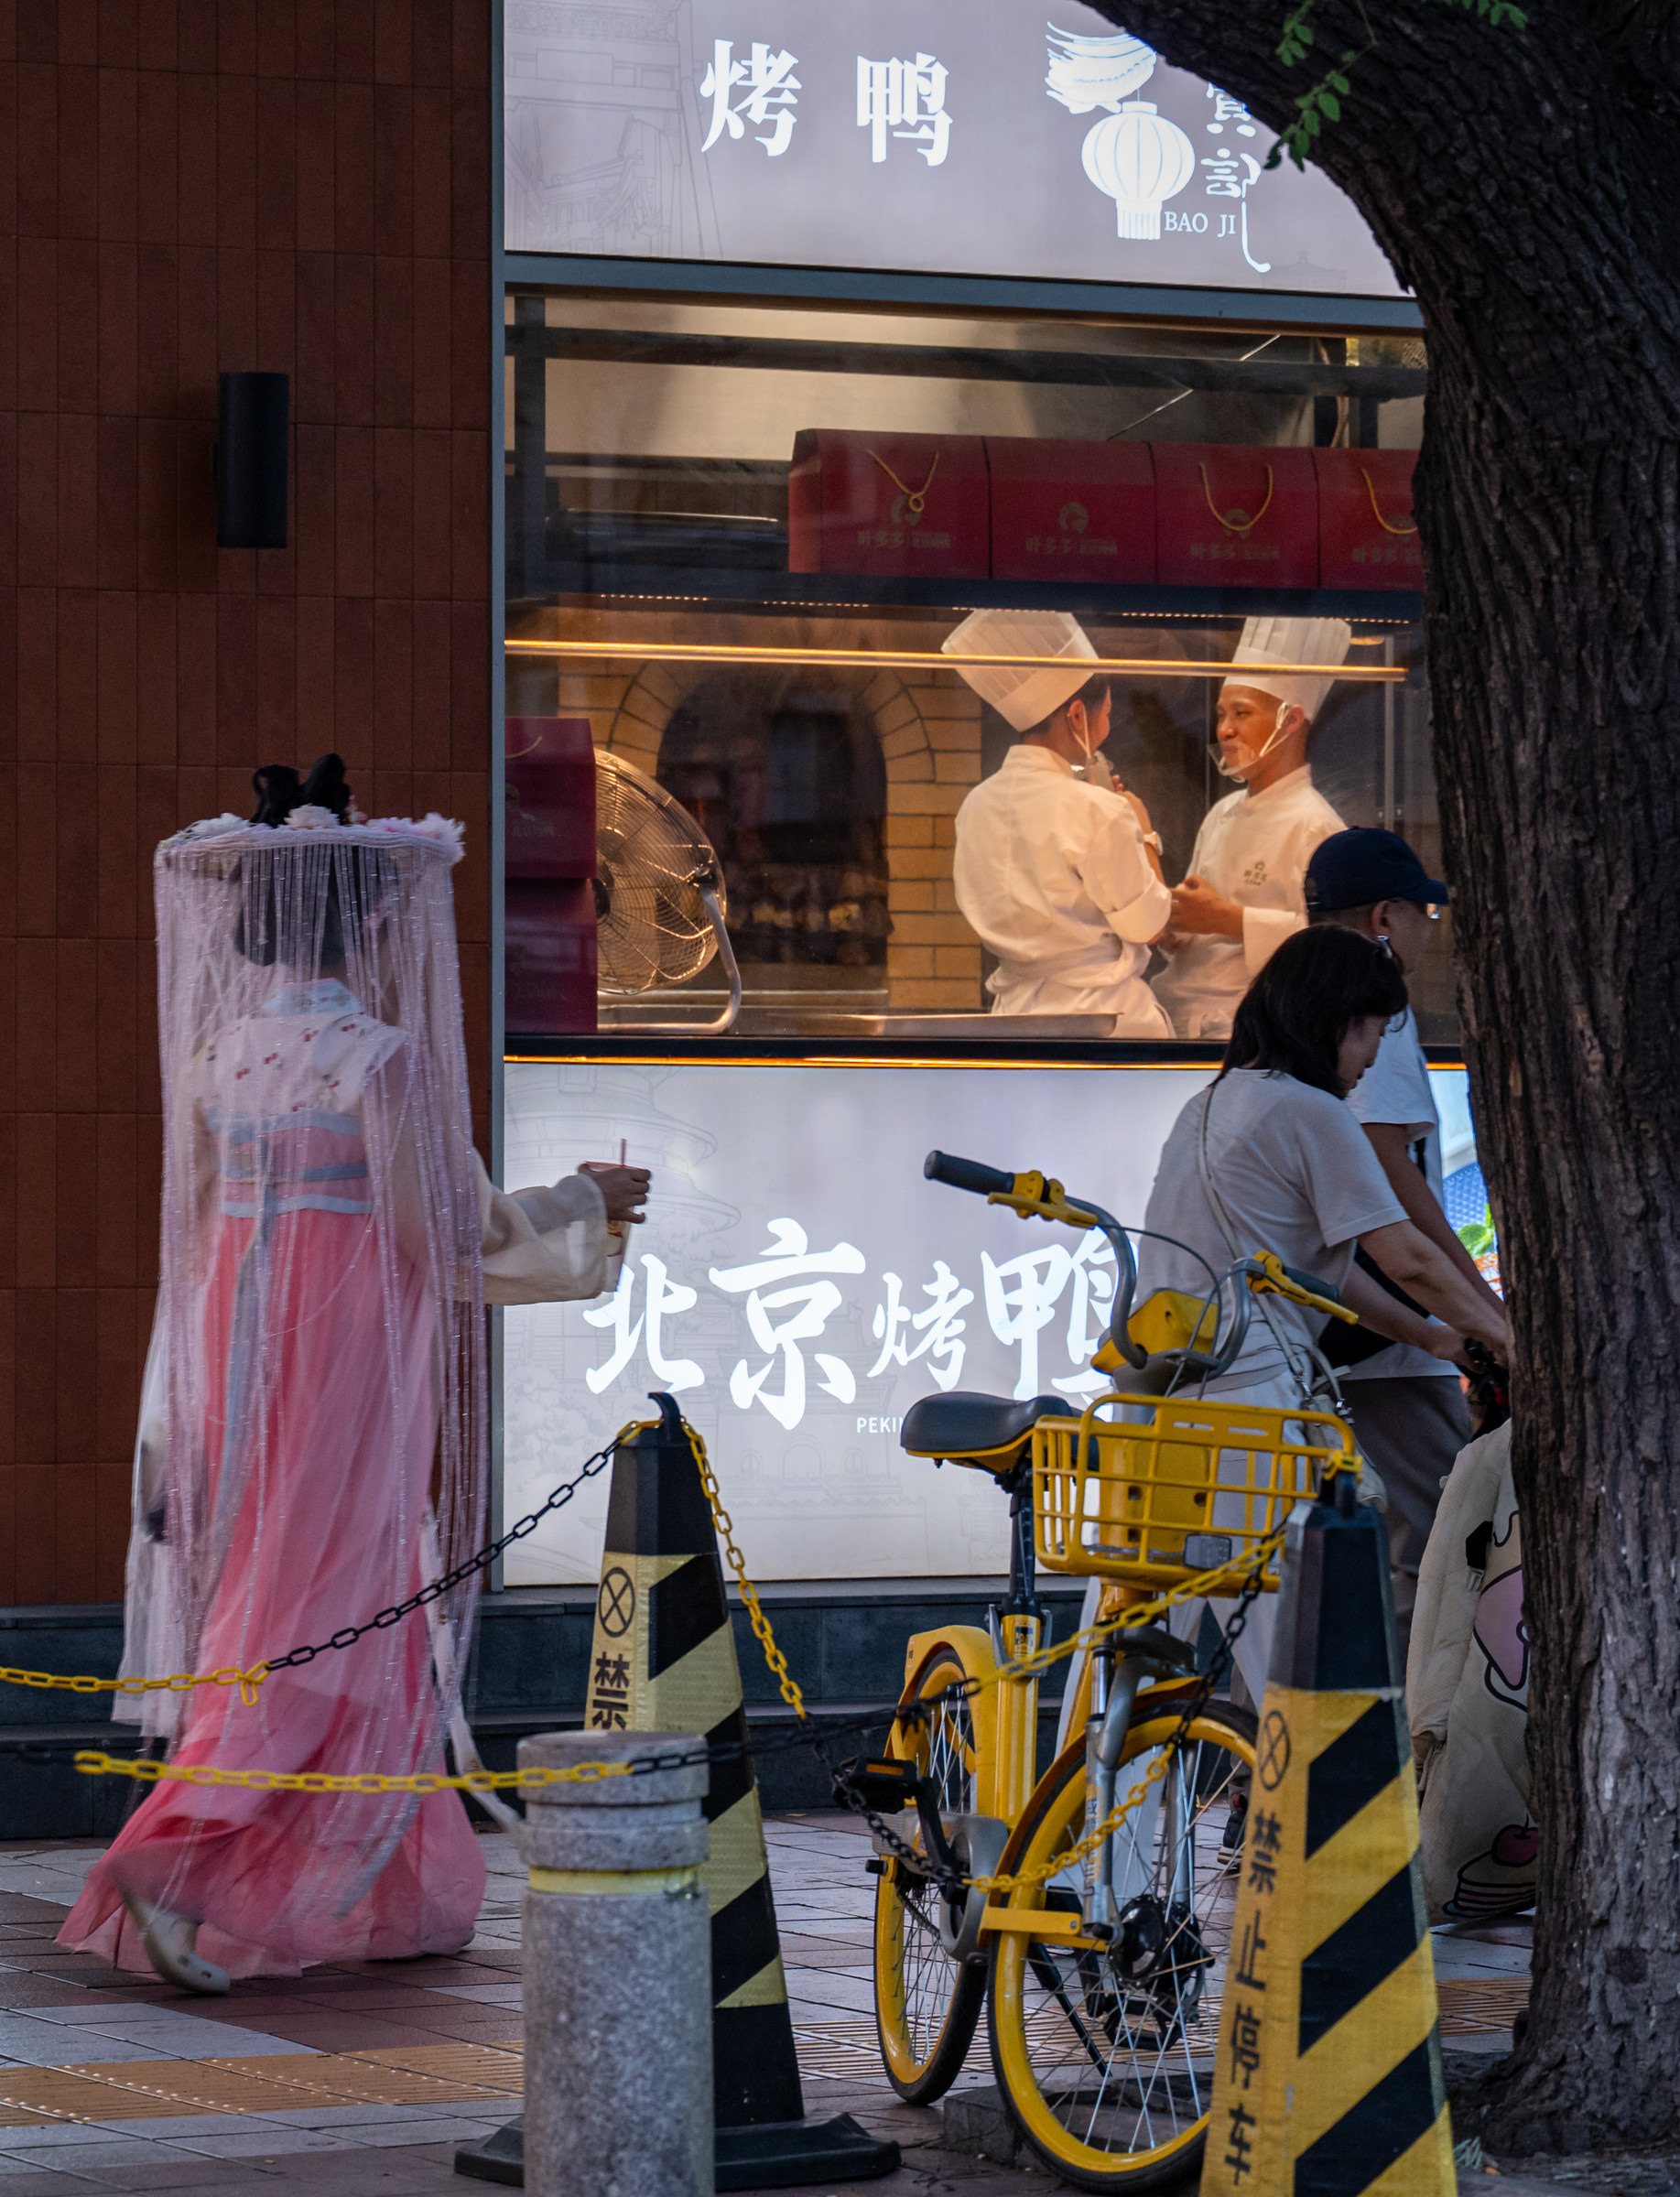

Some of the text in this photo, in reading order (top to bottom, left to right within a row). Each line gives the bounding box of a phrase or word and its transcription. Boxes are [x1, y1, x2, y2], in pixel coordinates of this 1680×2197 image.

[699, 39, 953, 167] 烤鸭
[1164, 211, 1236, 238] BAO JI
[583, 1218, 1138, 1430] 北京烤鸭
[591, 1651, 630, 1731] 禁
[1224, 1811, 1282, 2186] 禁止停车
